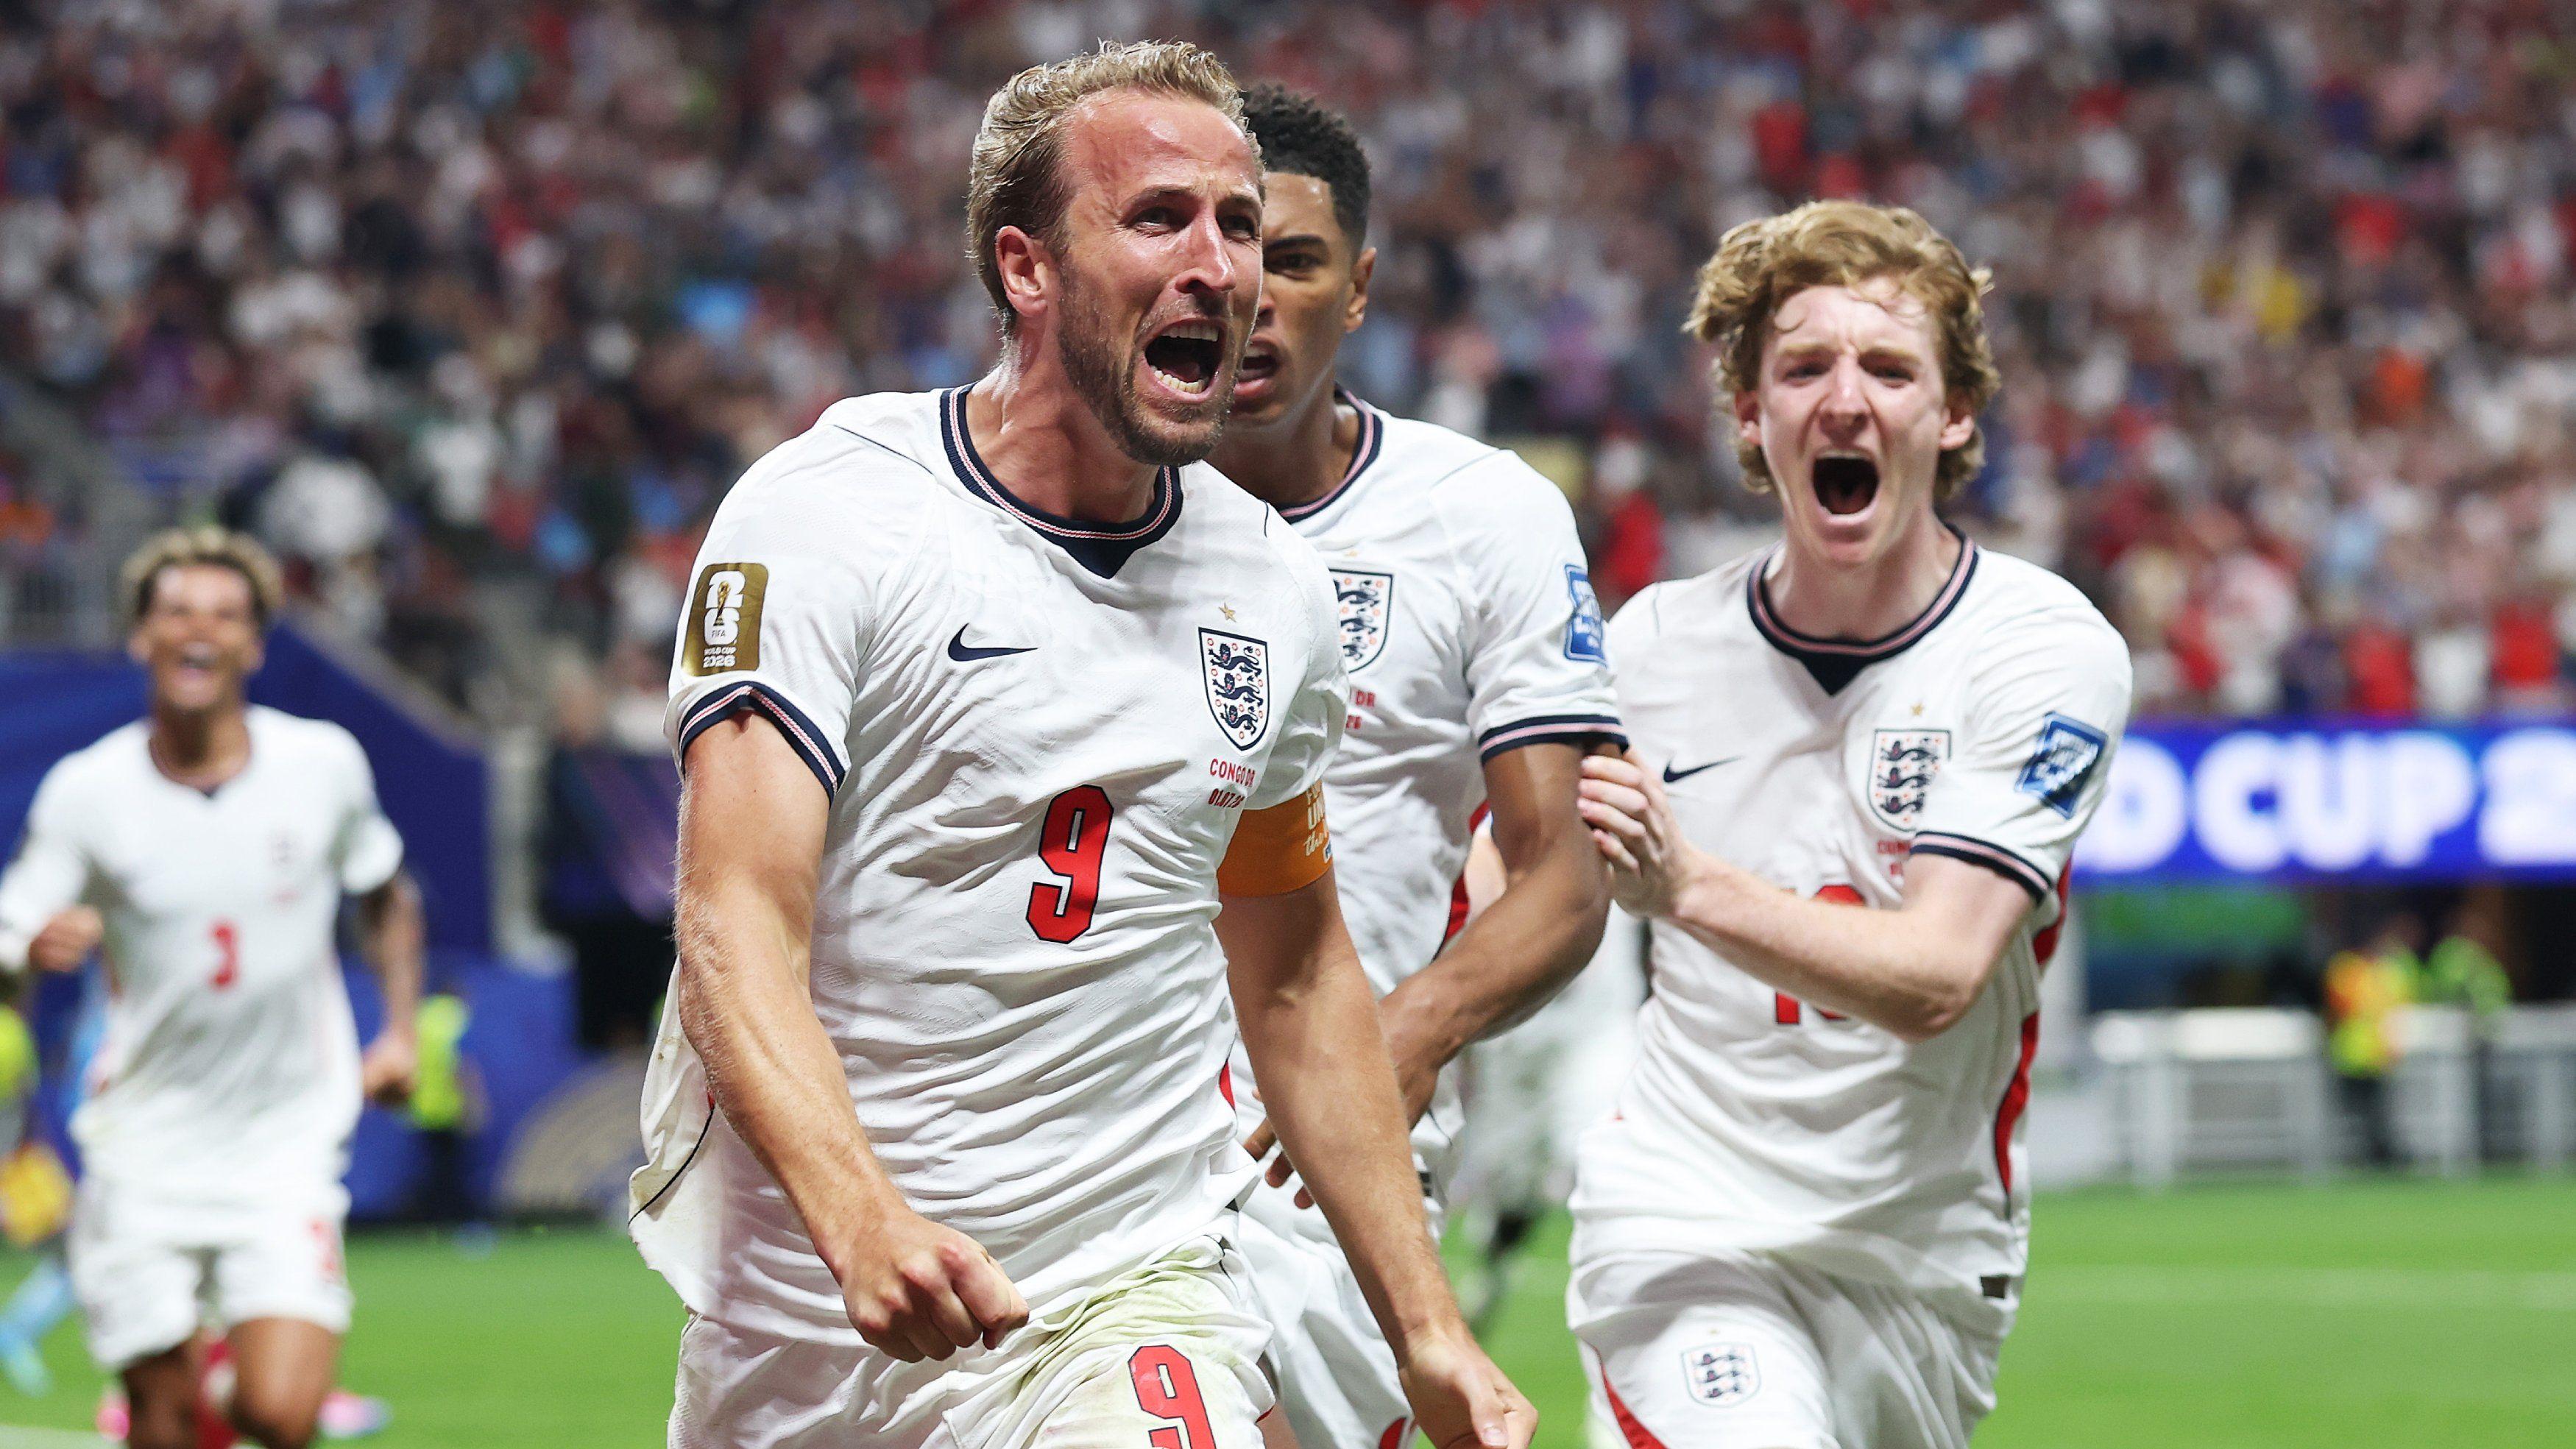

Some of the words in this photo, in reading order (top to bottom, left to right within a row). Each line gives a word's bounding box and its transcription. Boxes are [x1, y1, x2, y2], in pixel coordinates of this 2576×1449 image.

[712, 630, 726, 638] FIFA
[703, 654, 735, 668] 2026
[721, 646, 737, 655] CUP
[1210, 758, 1246, 784] CONGO
[2192, 729, 2477, 873] CUP
[1026, 784, 1114, 944] 9
[1128, 1345, 1217, 1449] 9
